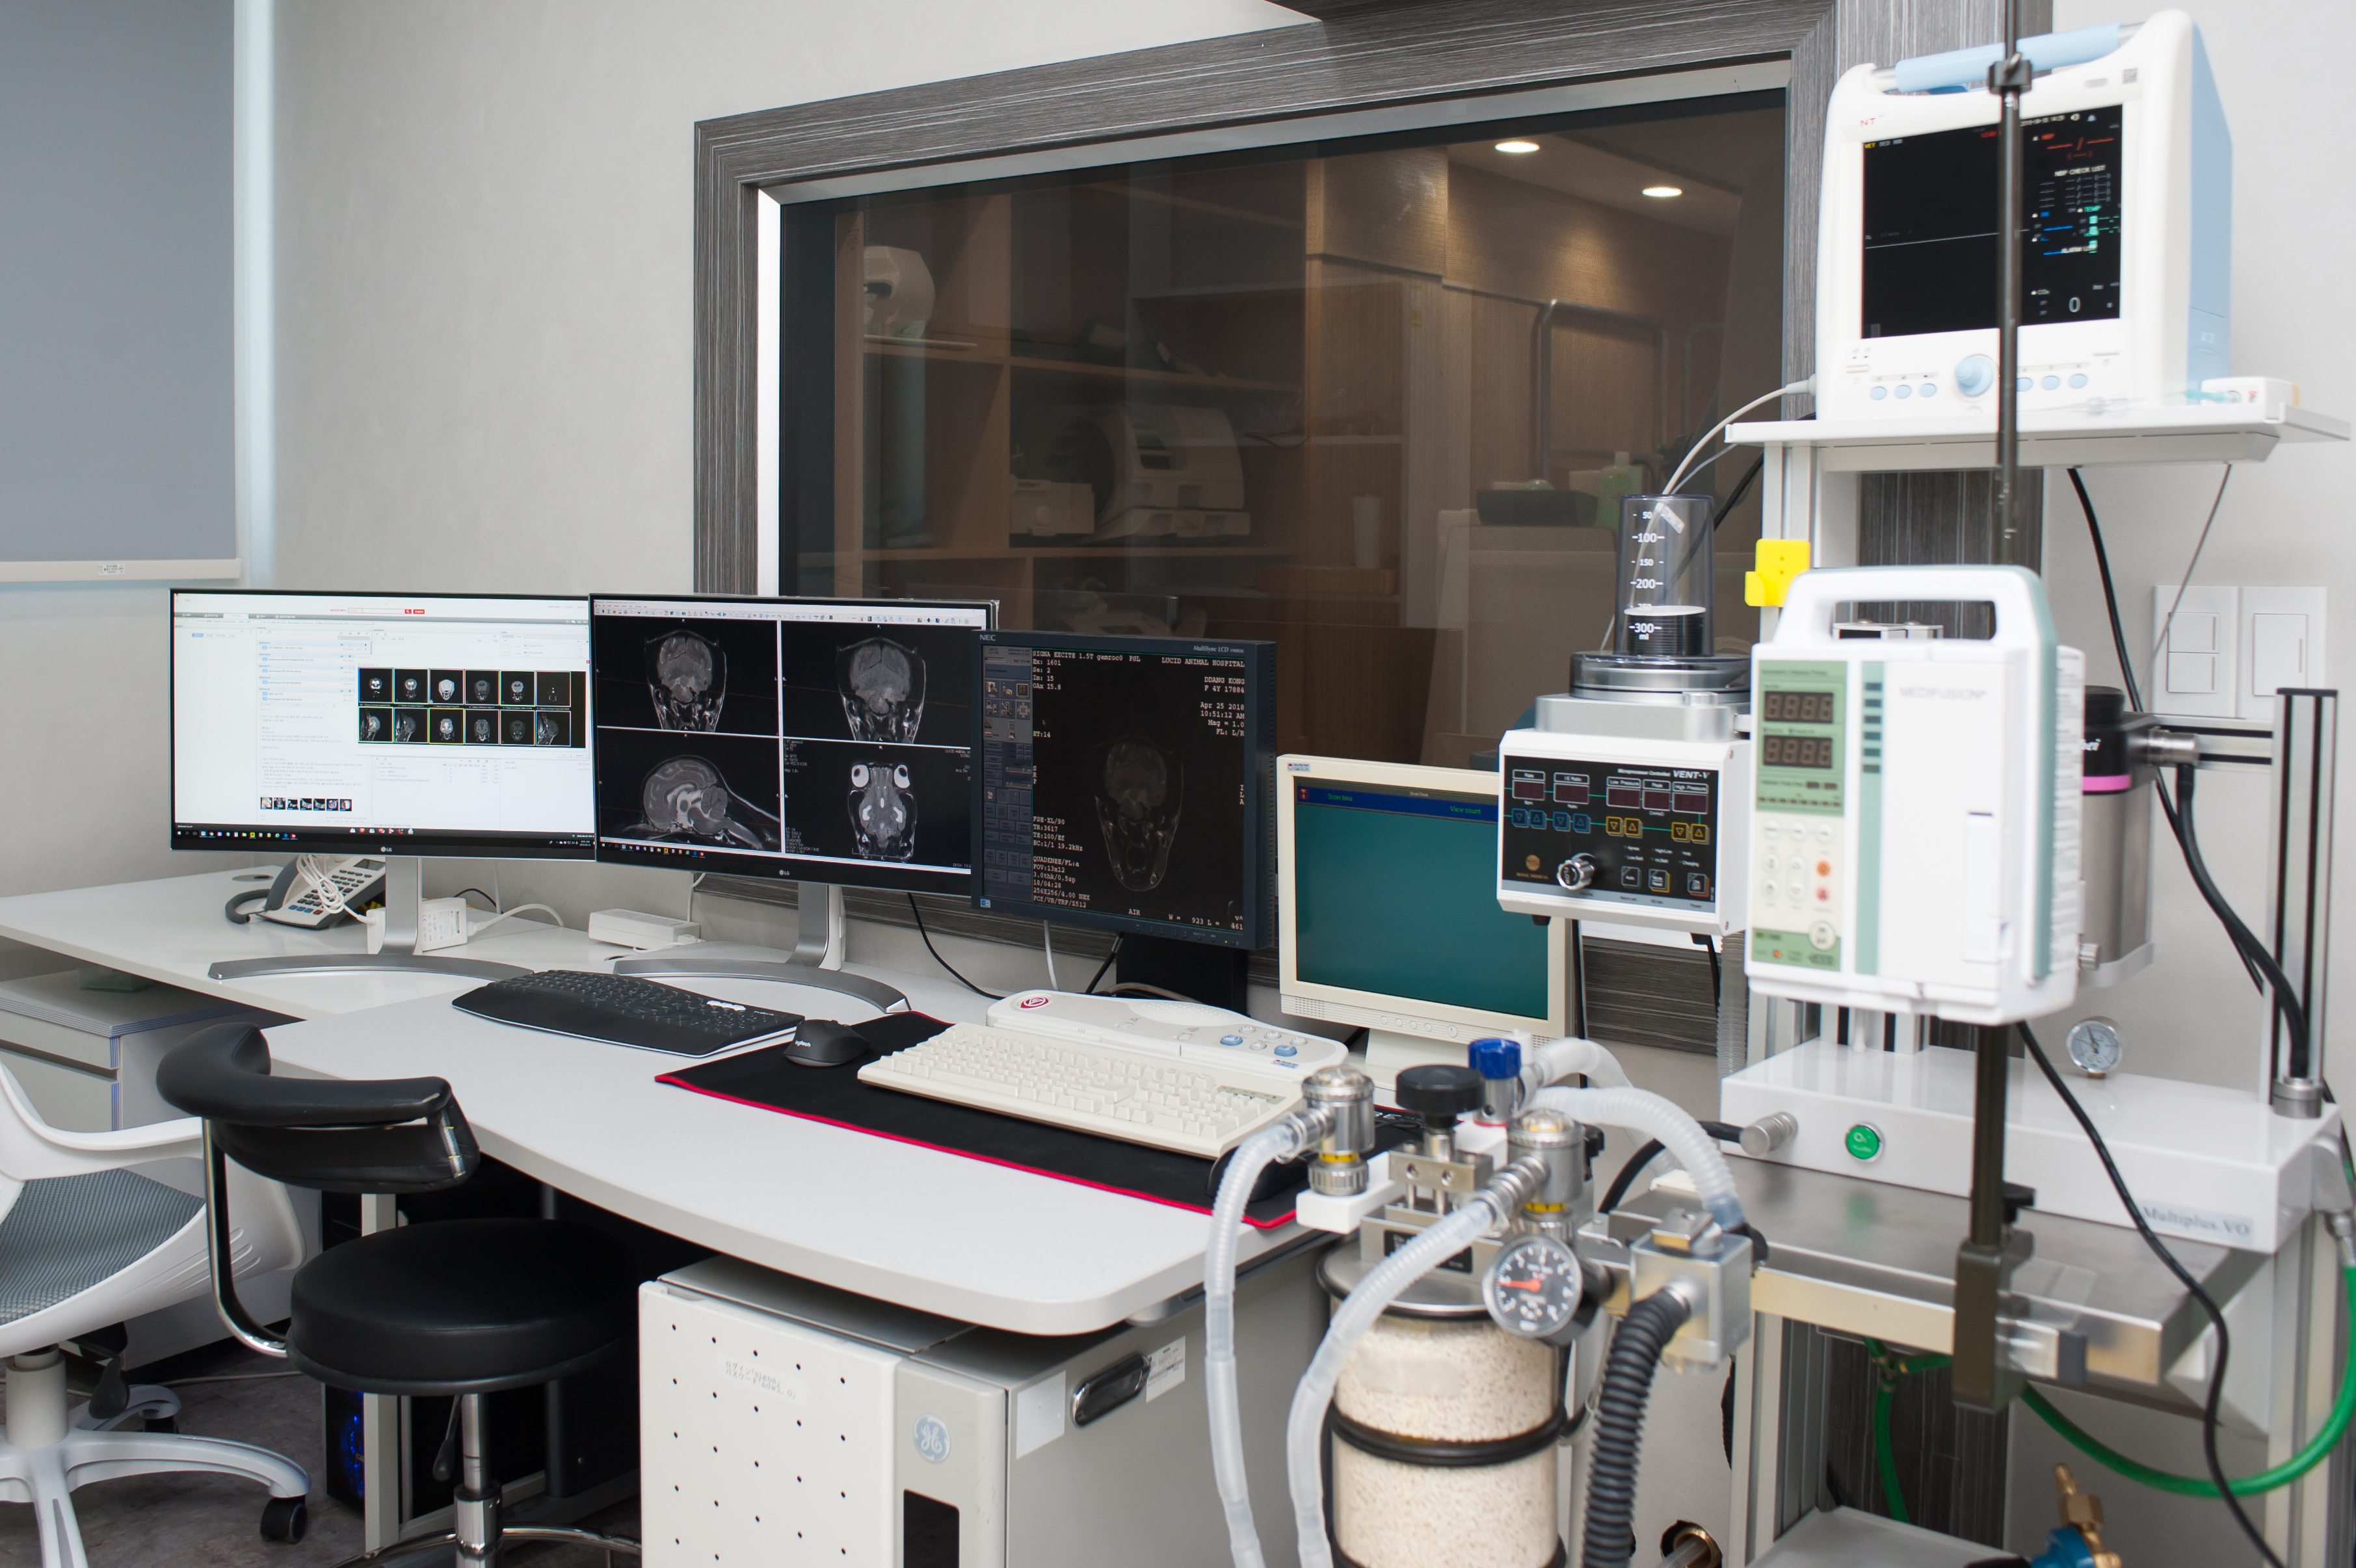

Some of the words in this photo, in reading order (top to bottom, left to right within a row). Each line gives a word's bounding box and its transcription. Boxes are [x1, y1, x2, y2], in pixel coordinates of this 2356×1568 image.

[2069, 296, 2081, 313] 0
[1642, 511, 1652, 520] 50
[1637, 533, 1658, 543] 100
[1635, 579, 1656, 589] 200
[1634, 622, 1654, 633] 300
